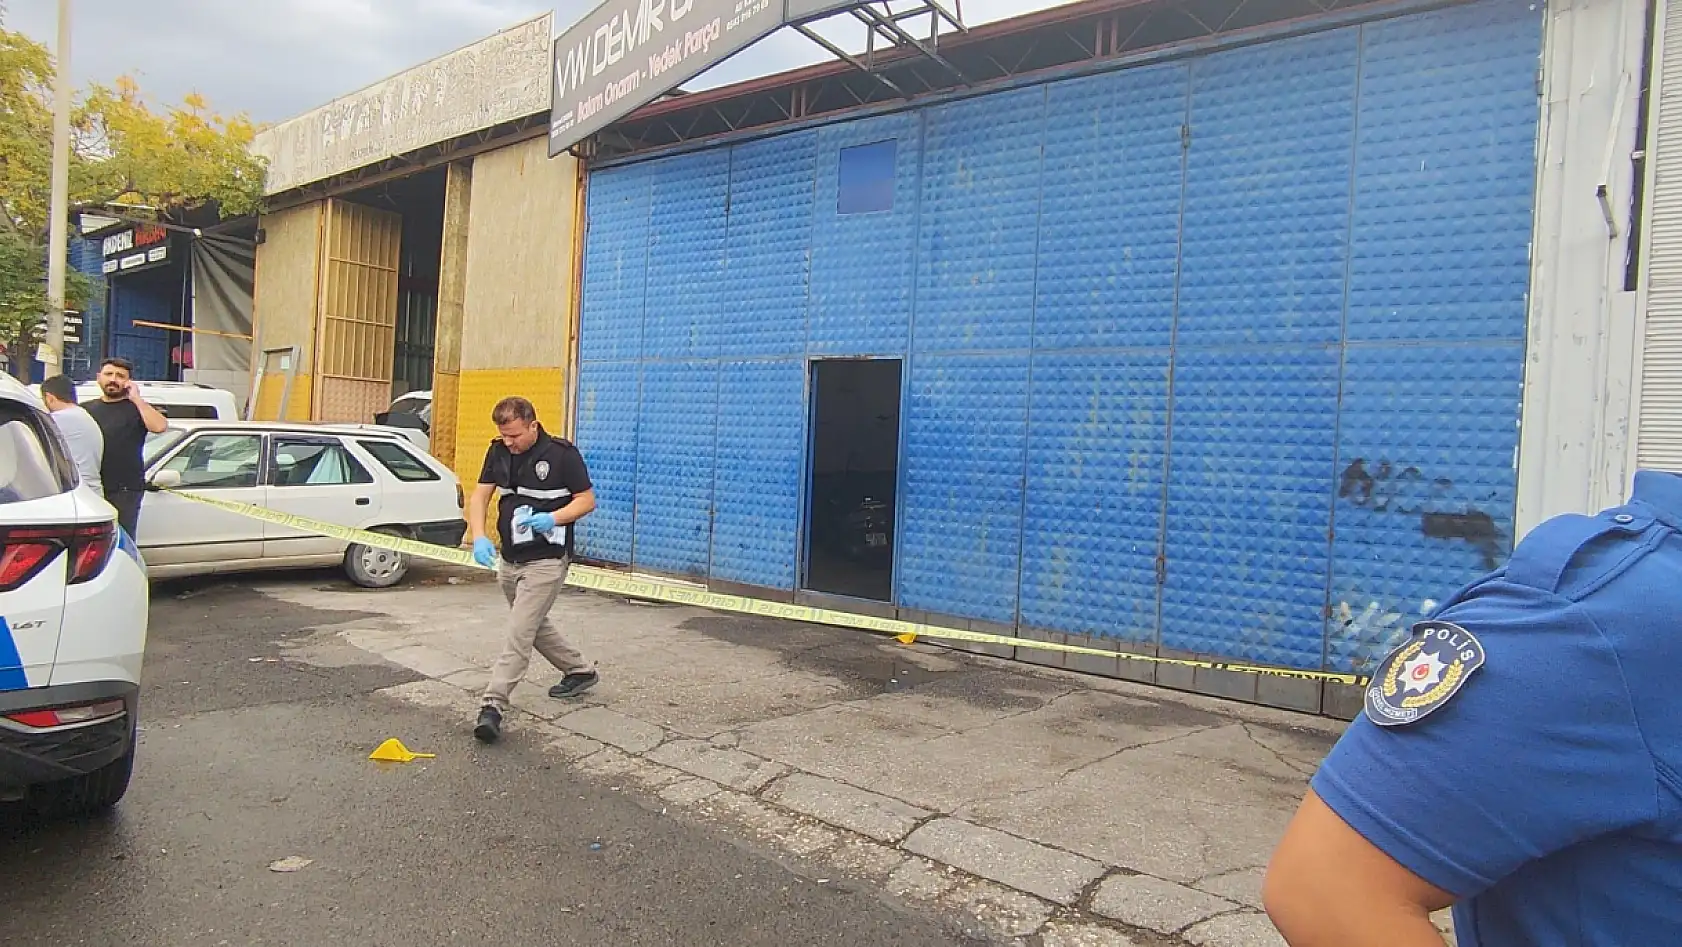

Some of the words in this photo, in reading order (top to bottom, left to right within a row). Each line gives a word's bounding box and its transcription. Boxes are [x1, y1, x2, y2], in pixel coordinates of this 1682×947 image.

[557, 35, 591, 99] VW
[648, 38, 682, 79] Yedek
[684, 16, 721, 59] Parça
[1423, 628, 1476, 661] POLİS
